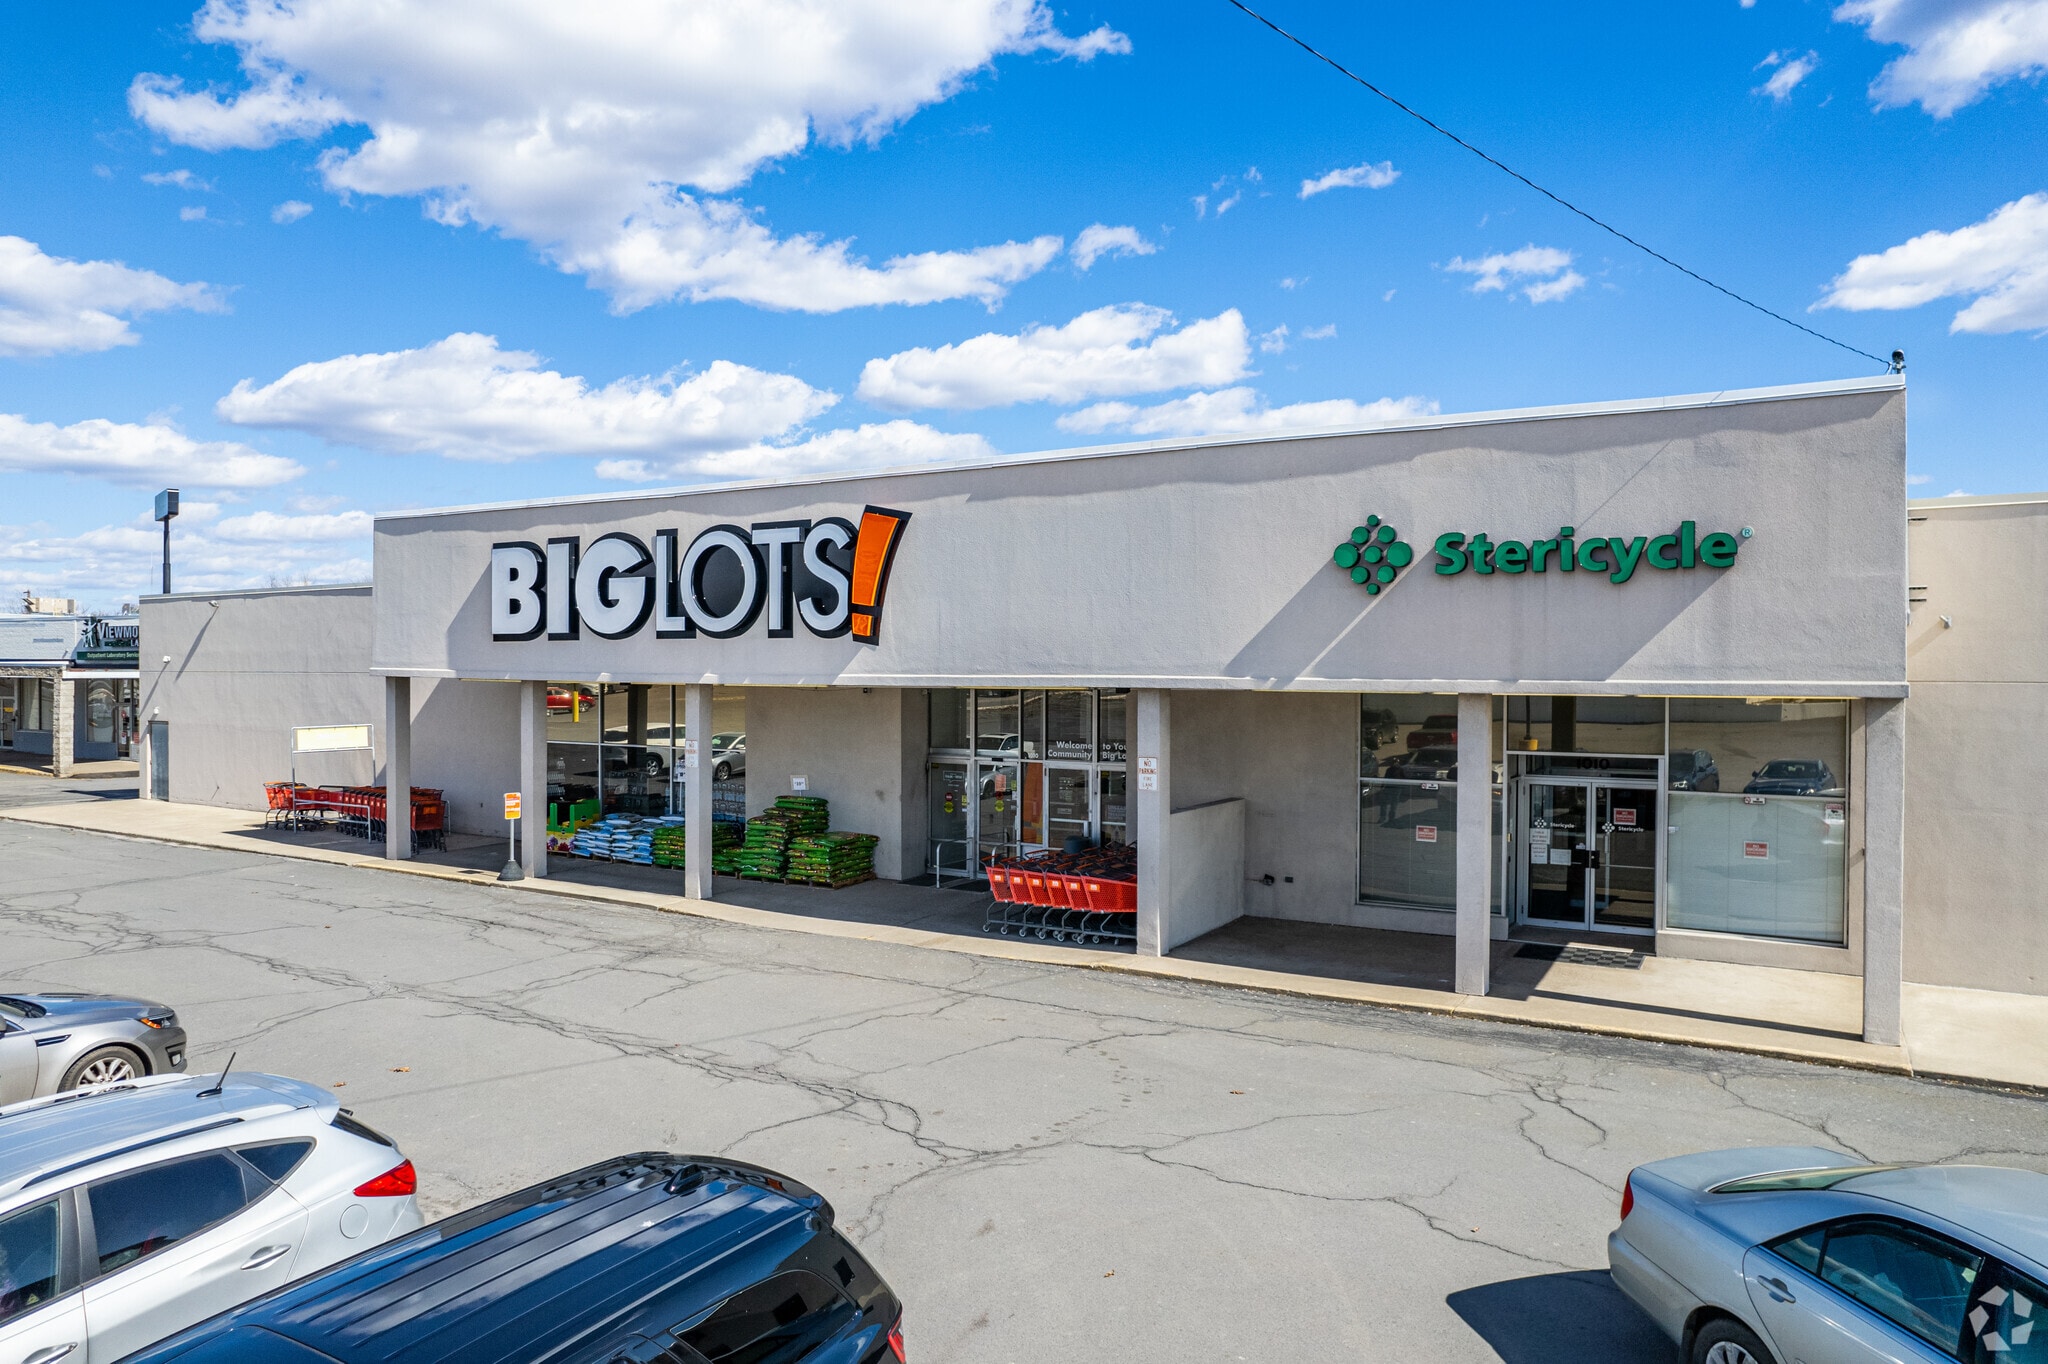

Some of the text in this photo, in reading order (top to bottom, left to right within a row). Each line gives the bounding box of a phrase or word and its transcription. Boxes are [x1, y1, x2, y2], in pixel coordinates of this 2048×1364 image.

[97, 622, 139, 640] VIEWMO
[130, 639, 139, 647] LA
[1056, 741, 1092, 750] Welcome
[1113, 743, 1127, 751] You
[1047, 749, 1127, 761] Community Big Lo
[1617, 825, 1644, 833] Stericycle
